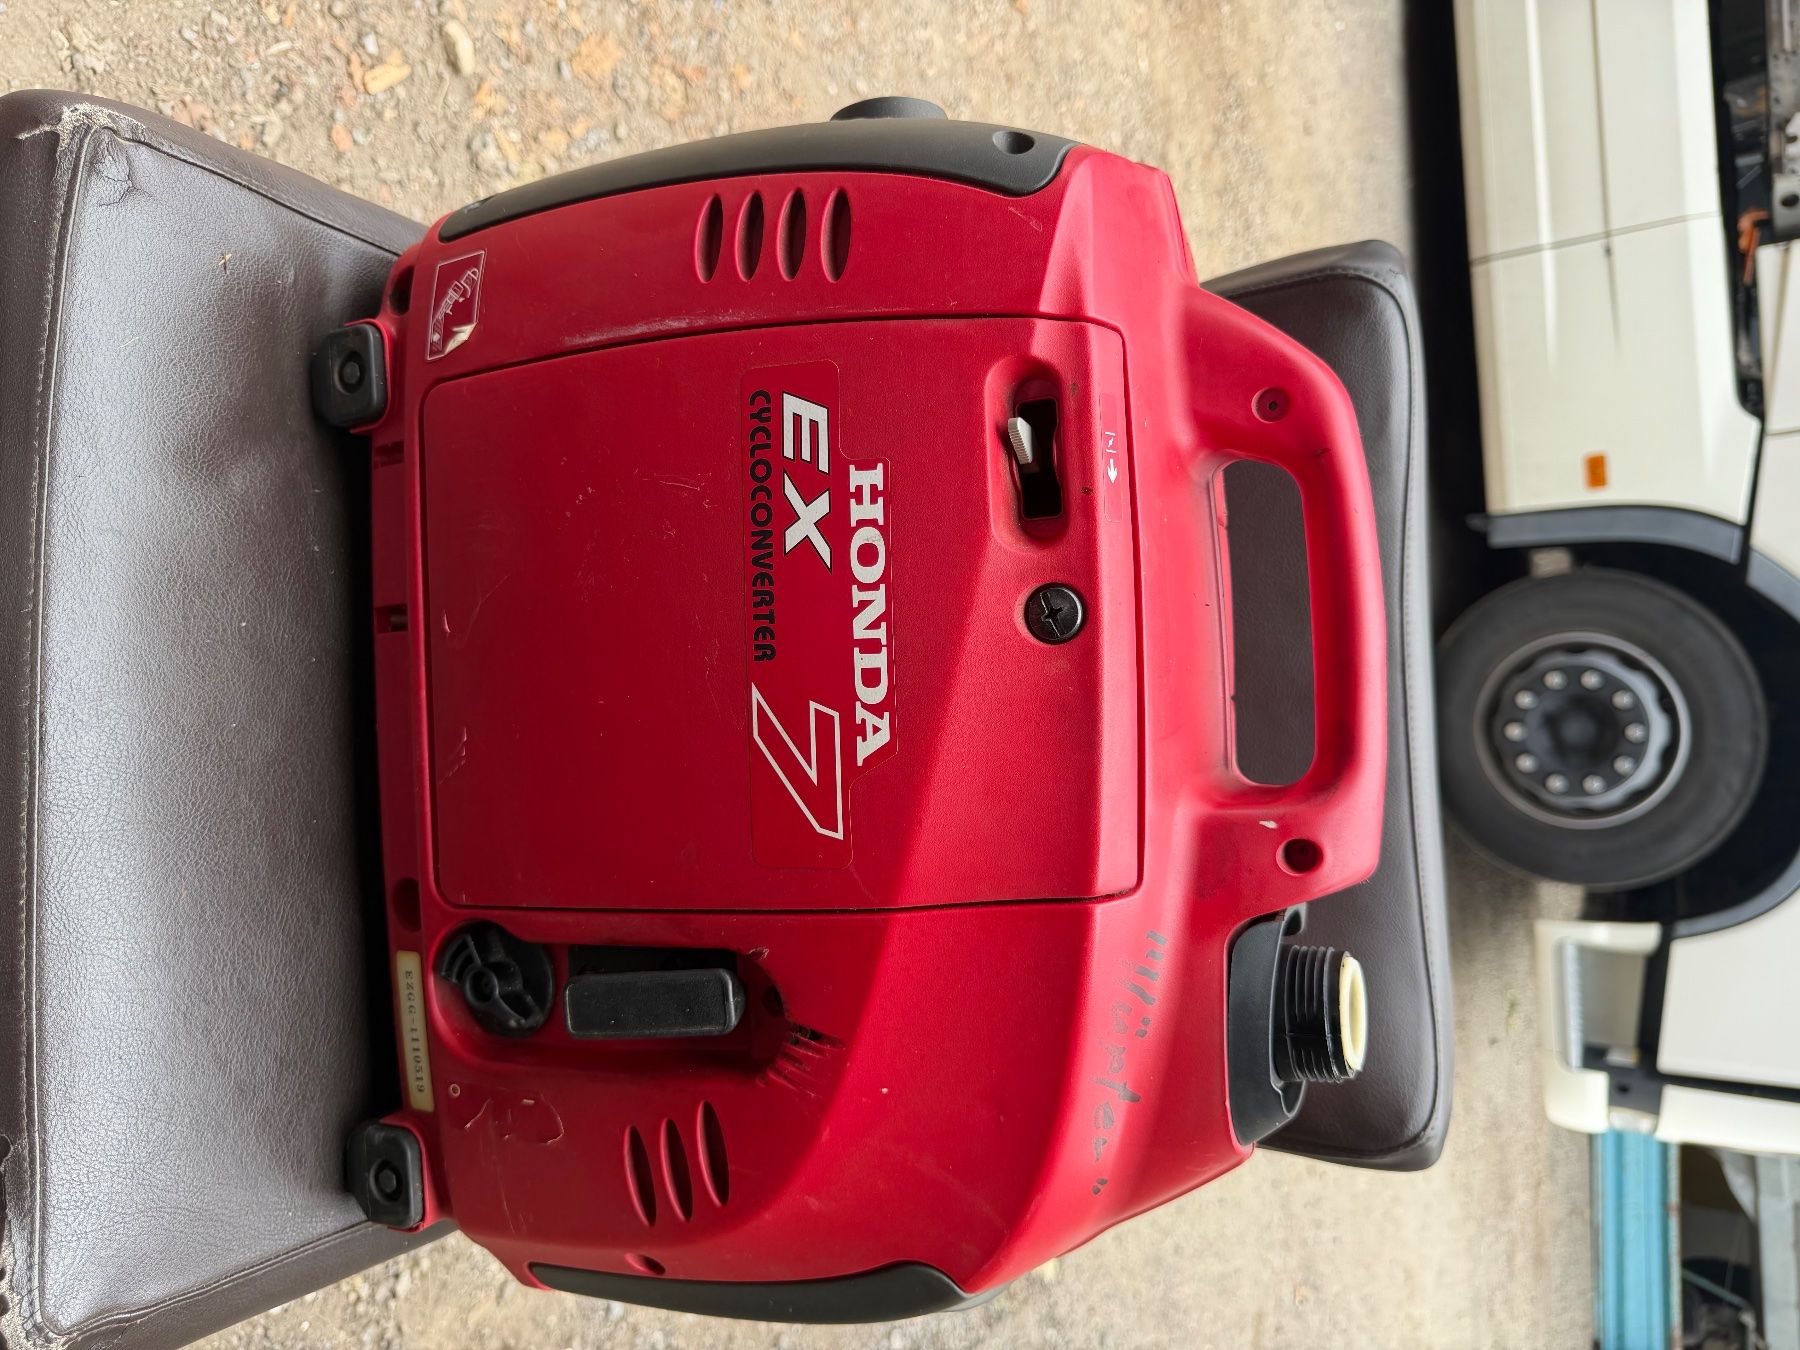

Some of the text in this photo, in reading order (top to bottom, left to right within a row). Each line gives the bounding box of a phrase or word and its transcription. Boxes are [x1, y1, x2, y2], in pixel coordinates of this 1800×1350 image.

[748, 389, 777, 663] CYCLOCONVERTER
[751, 390, 844, 841] EX 7
[849, 462, 891, 767] HONDA
[404, 969, 426, 1093] EZGG-1110519
